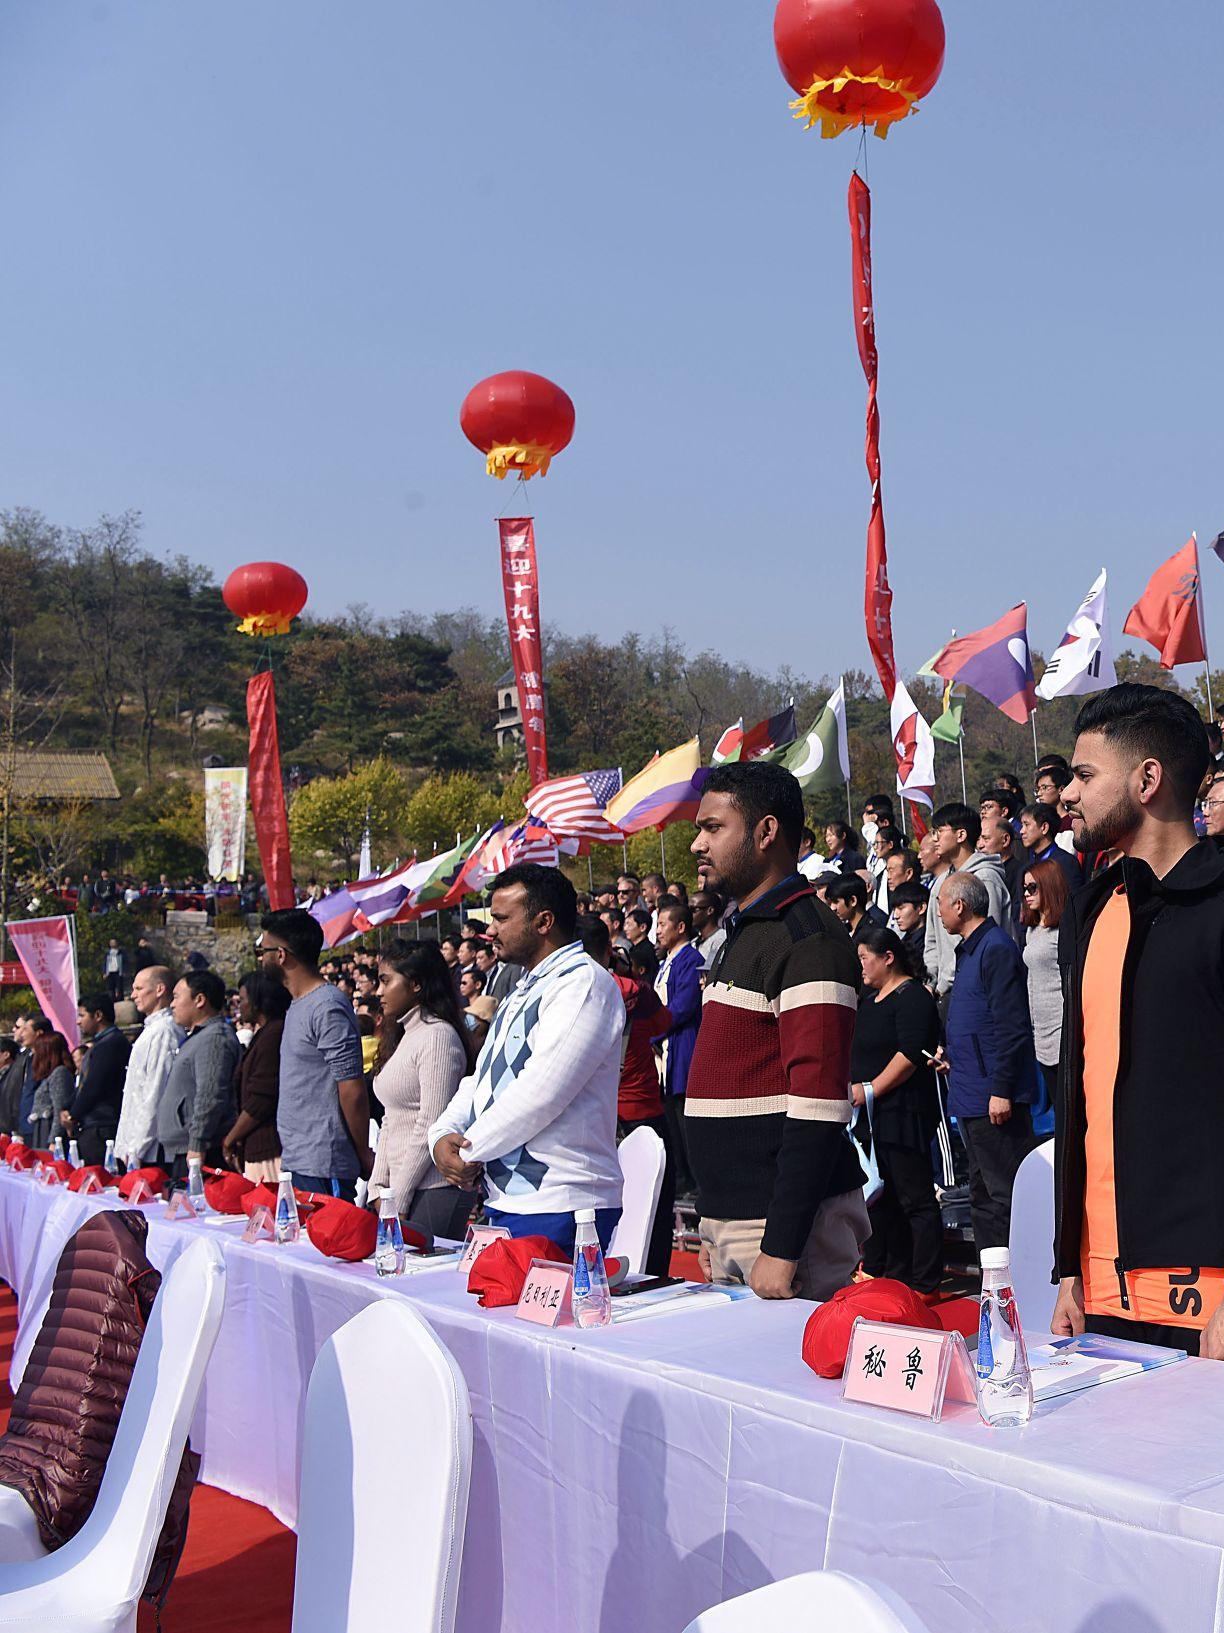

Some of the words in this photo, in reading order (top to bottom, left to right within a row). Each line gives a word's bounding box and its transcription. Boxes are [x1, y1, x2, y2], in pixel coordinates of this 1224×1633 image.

[523, 1282, 560, 1309] 尼日利亚
[862, 1344, 923, 1391] 秘鲁
